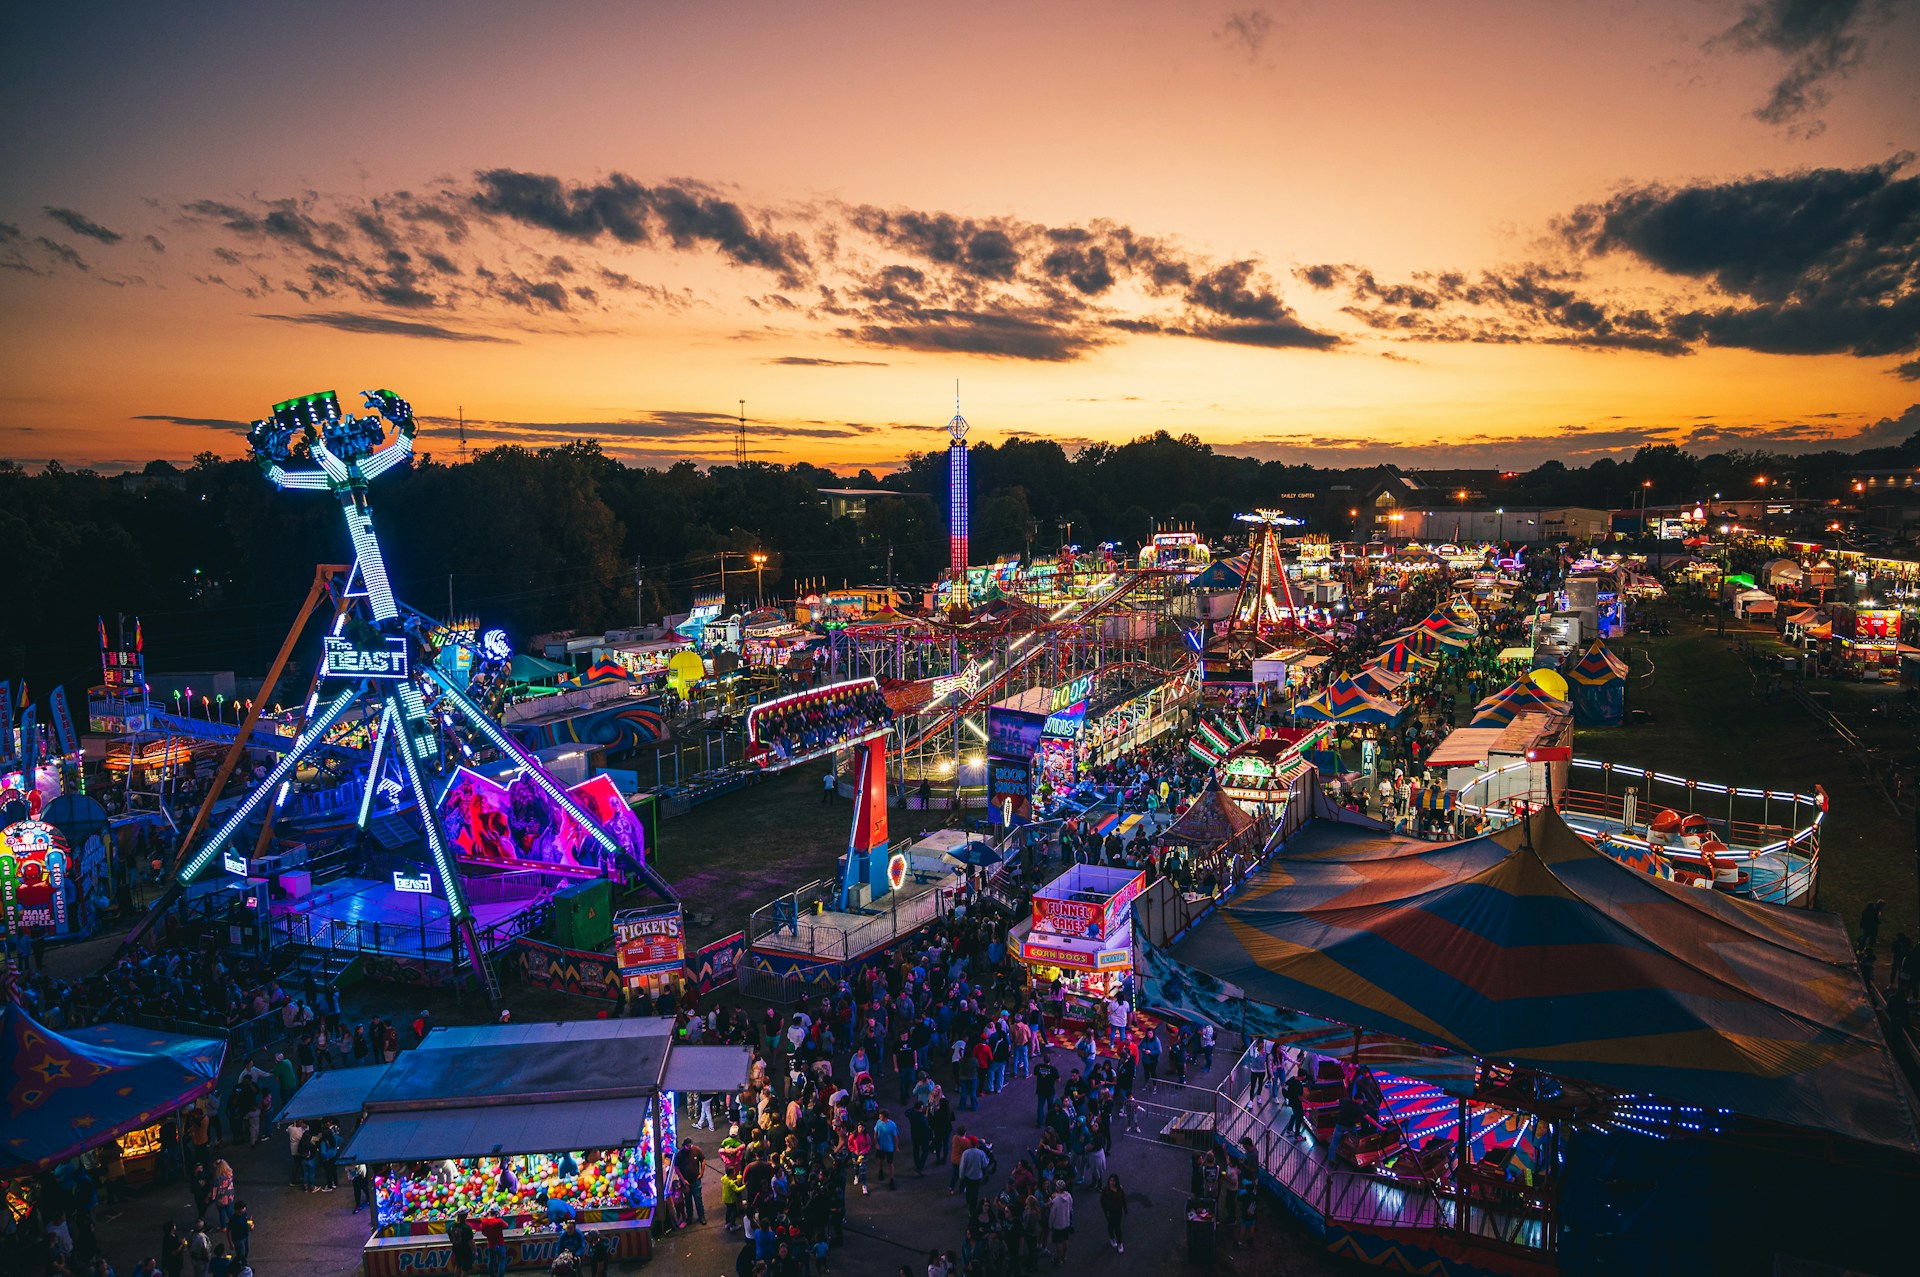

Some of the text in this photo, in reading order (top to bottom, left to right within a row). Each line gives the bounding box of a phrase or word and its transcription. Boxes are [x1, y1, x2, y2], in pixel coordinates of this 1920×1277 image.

[328, 651, 407, 672] BEAST
[1051, 674, 1095, 711] HOOPS
[999, 715, 1024, 729] WIN
[1000, 728, 1020, 740] BIG
[991, 740, 1028, 757] HERE!
[1363, 740, 1373, 776] ATM
[995, 768, 1027, 781] HOOP
[994, 782, 1028, 795] SHOTS
[4, 880, 13, 901] COLD
[23, 908, 50, 916] HALF
[1048, 901, 1090, 920] FUNNEL
[617, 918, 678, 944] TICKETS
[1051, 916, 1087, 933] CAKES
[1030, 948, 1087, 963] CORN DOGS
[399, 1249, 452, 1271] PLAY
